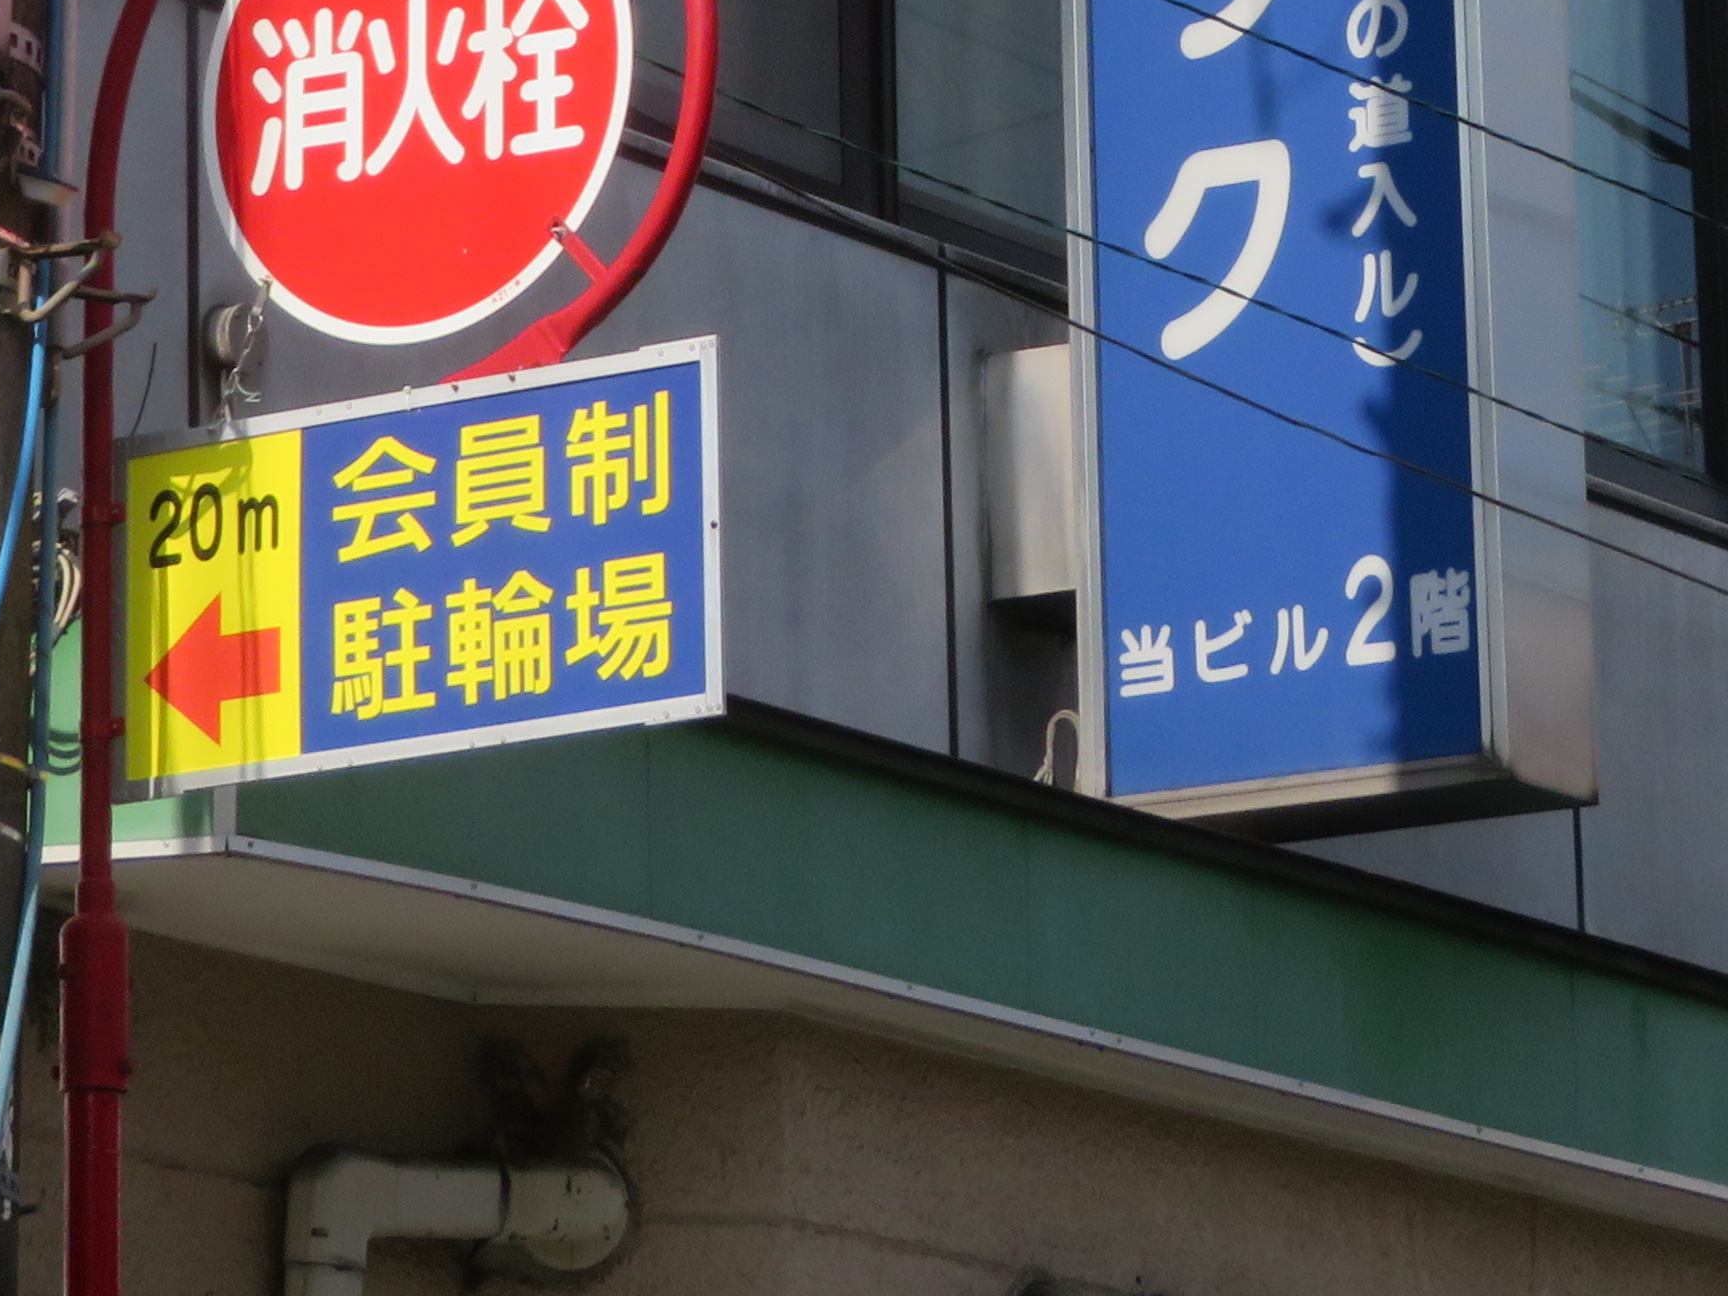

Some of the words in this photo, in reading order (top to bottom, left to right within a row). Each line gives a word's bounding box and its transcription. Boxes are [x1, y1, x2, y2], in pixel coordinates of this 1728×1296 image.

[332, 390, 671, 564] 会員制
[331, 552, 673, 721] 駐輪場
[1119, 554, 1471, 699] 当ビル2階
